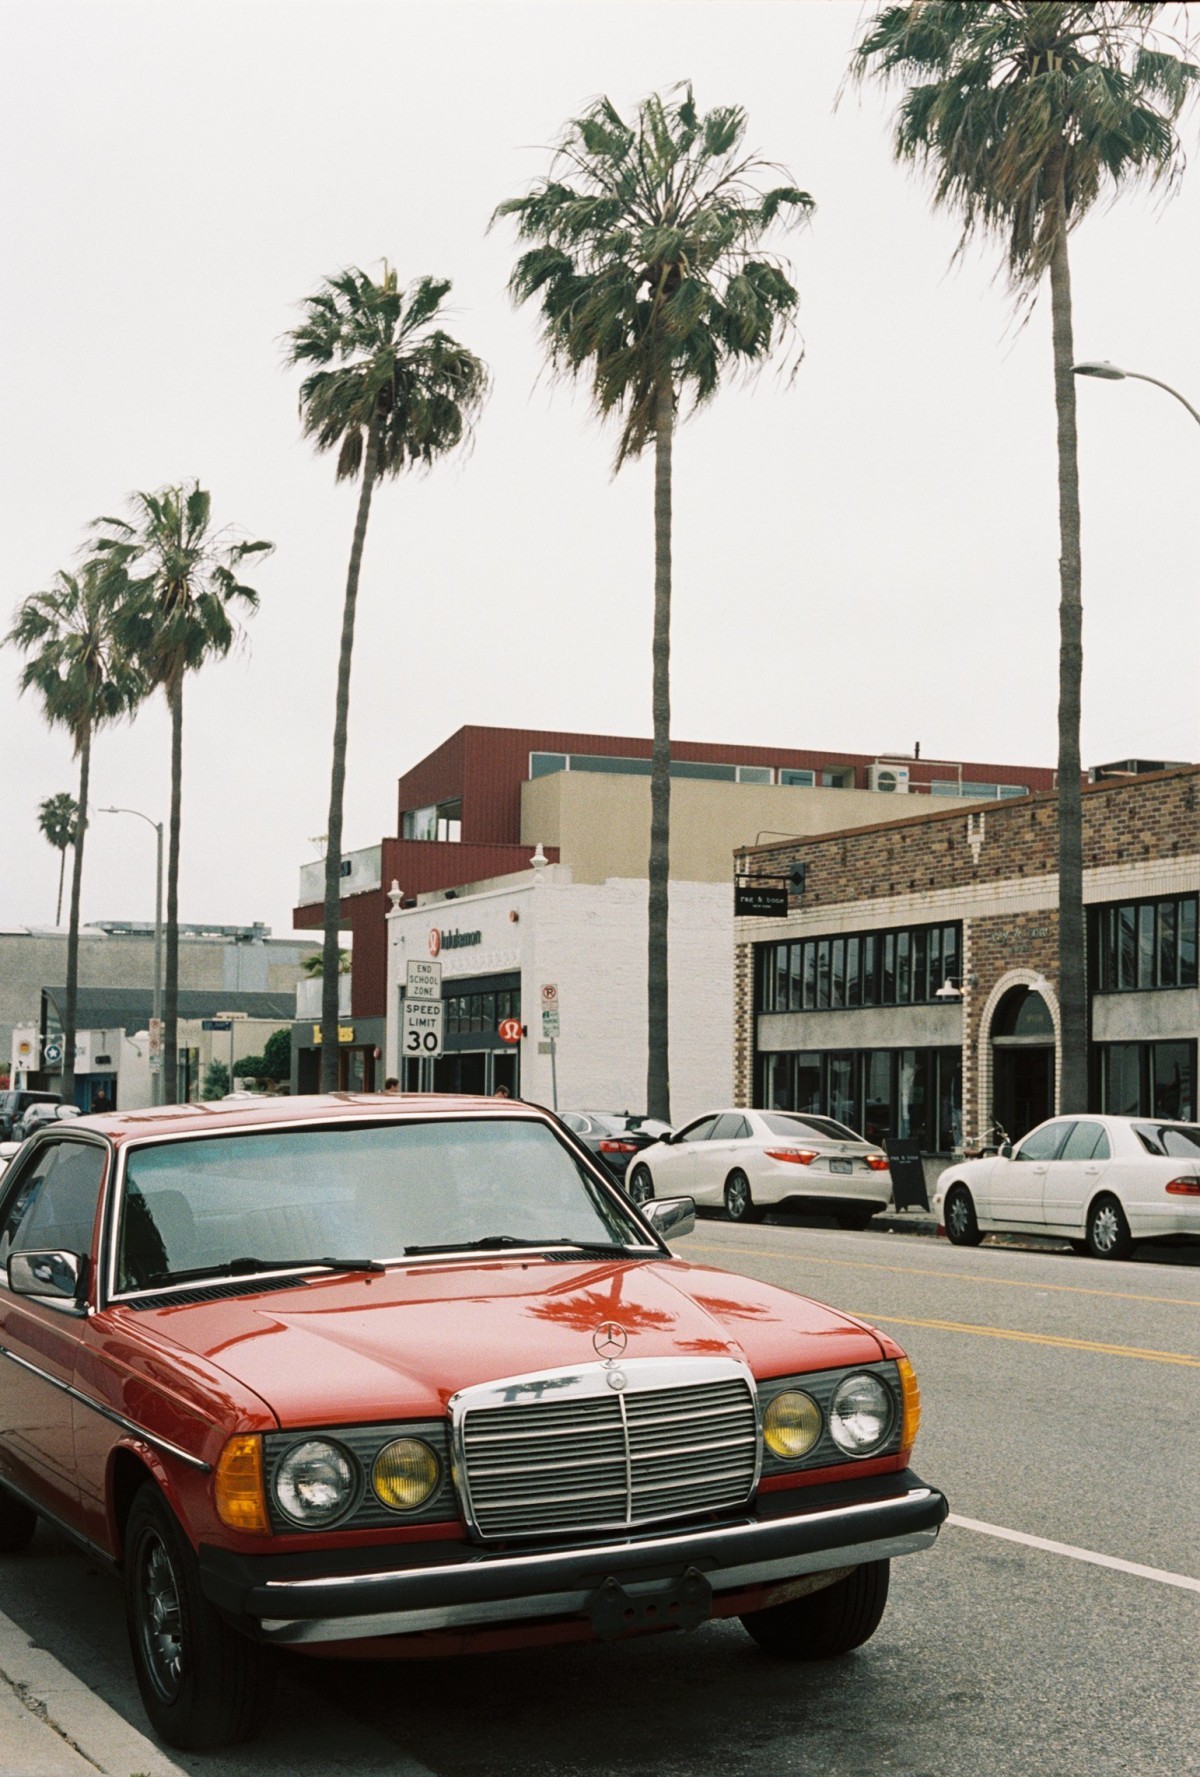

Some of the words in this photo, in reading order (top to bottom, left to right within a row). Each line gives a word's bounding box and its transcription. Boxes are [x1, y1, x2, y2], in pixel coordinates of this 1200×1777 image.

[417, 965, 432, 973] END
[409, 975, 439, 985] SCHOOL
[414, 986, 434, 996] ZONE
[406, 1004, 441, 1015] SPEED
[409, 1018, 437, 1028] LIMIT
[406, 1030, 439, 1052] 30
